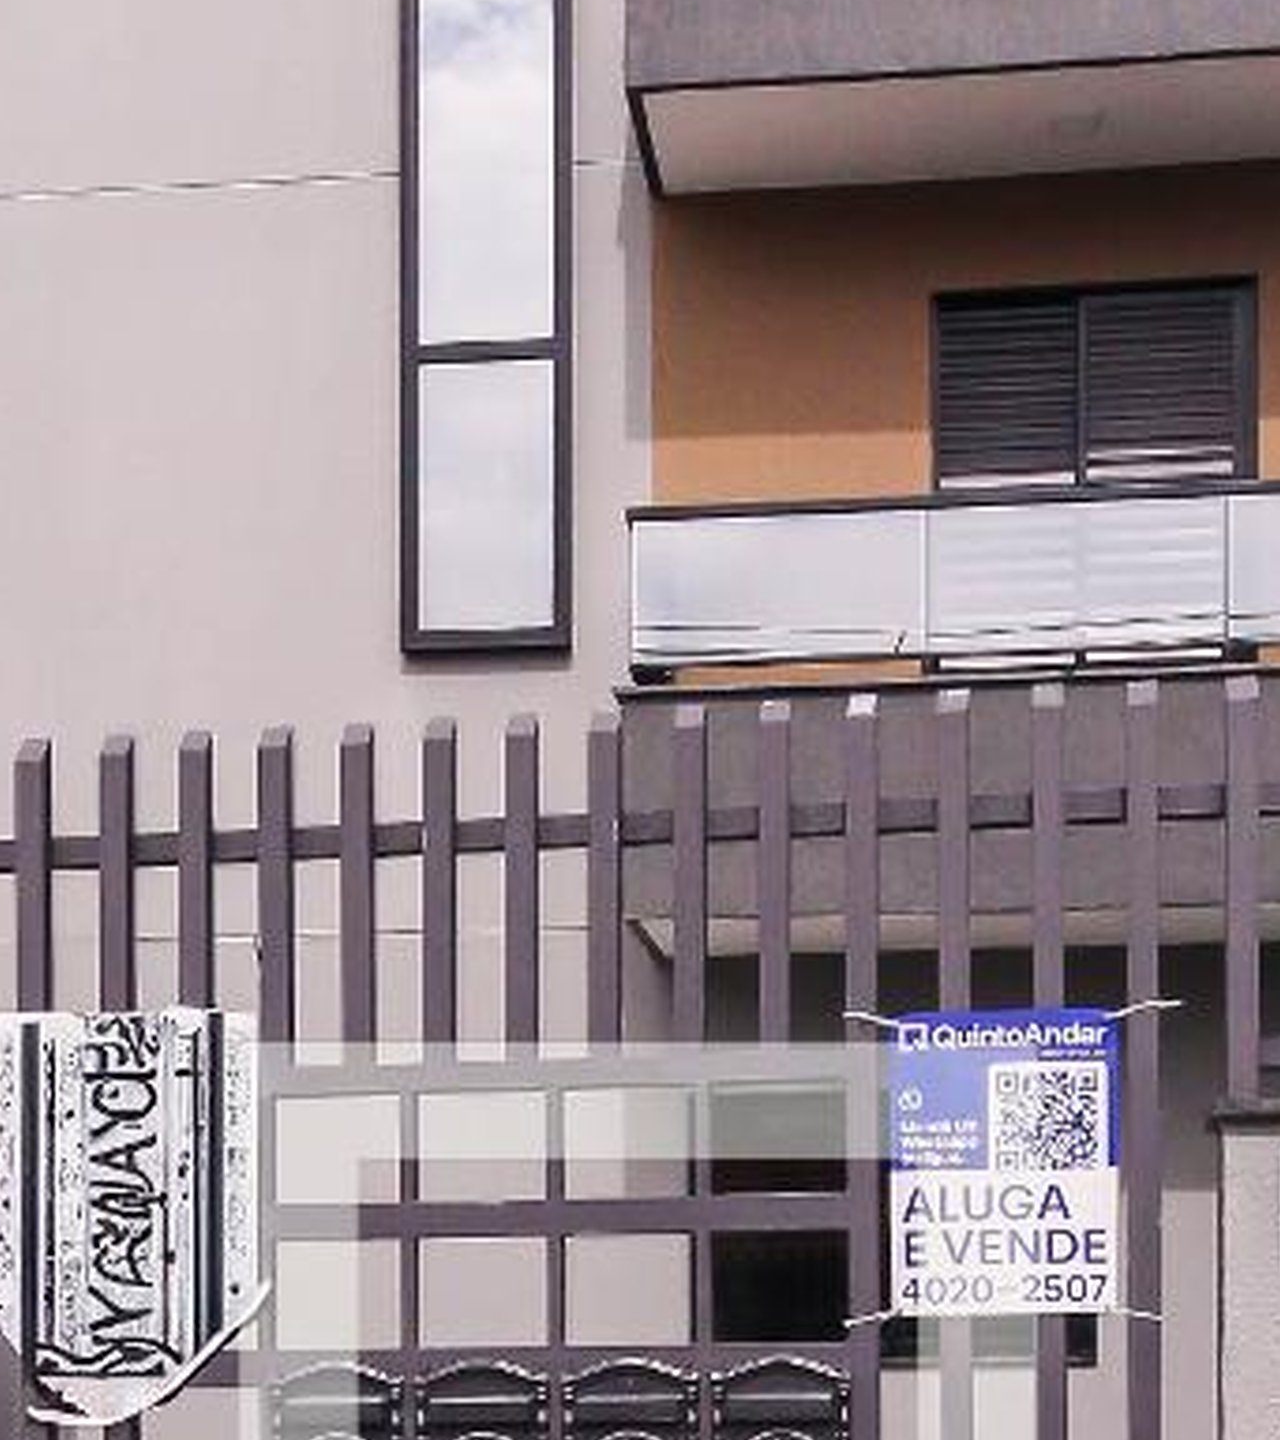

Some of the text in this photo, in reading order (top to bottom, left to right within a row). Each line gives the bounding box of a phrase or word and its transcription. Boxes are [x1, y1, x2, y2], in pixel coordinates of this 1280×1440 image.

[932, 1022, 1108, 1050] QuintoAndar
[902, 1184, 1072, 1223] ALUGA
[904, 1228, 1108, 1268] E VENDE
